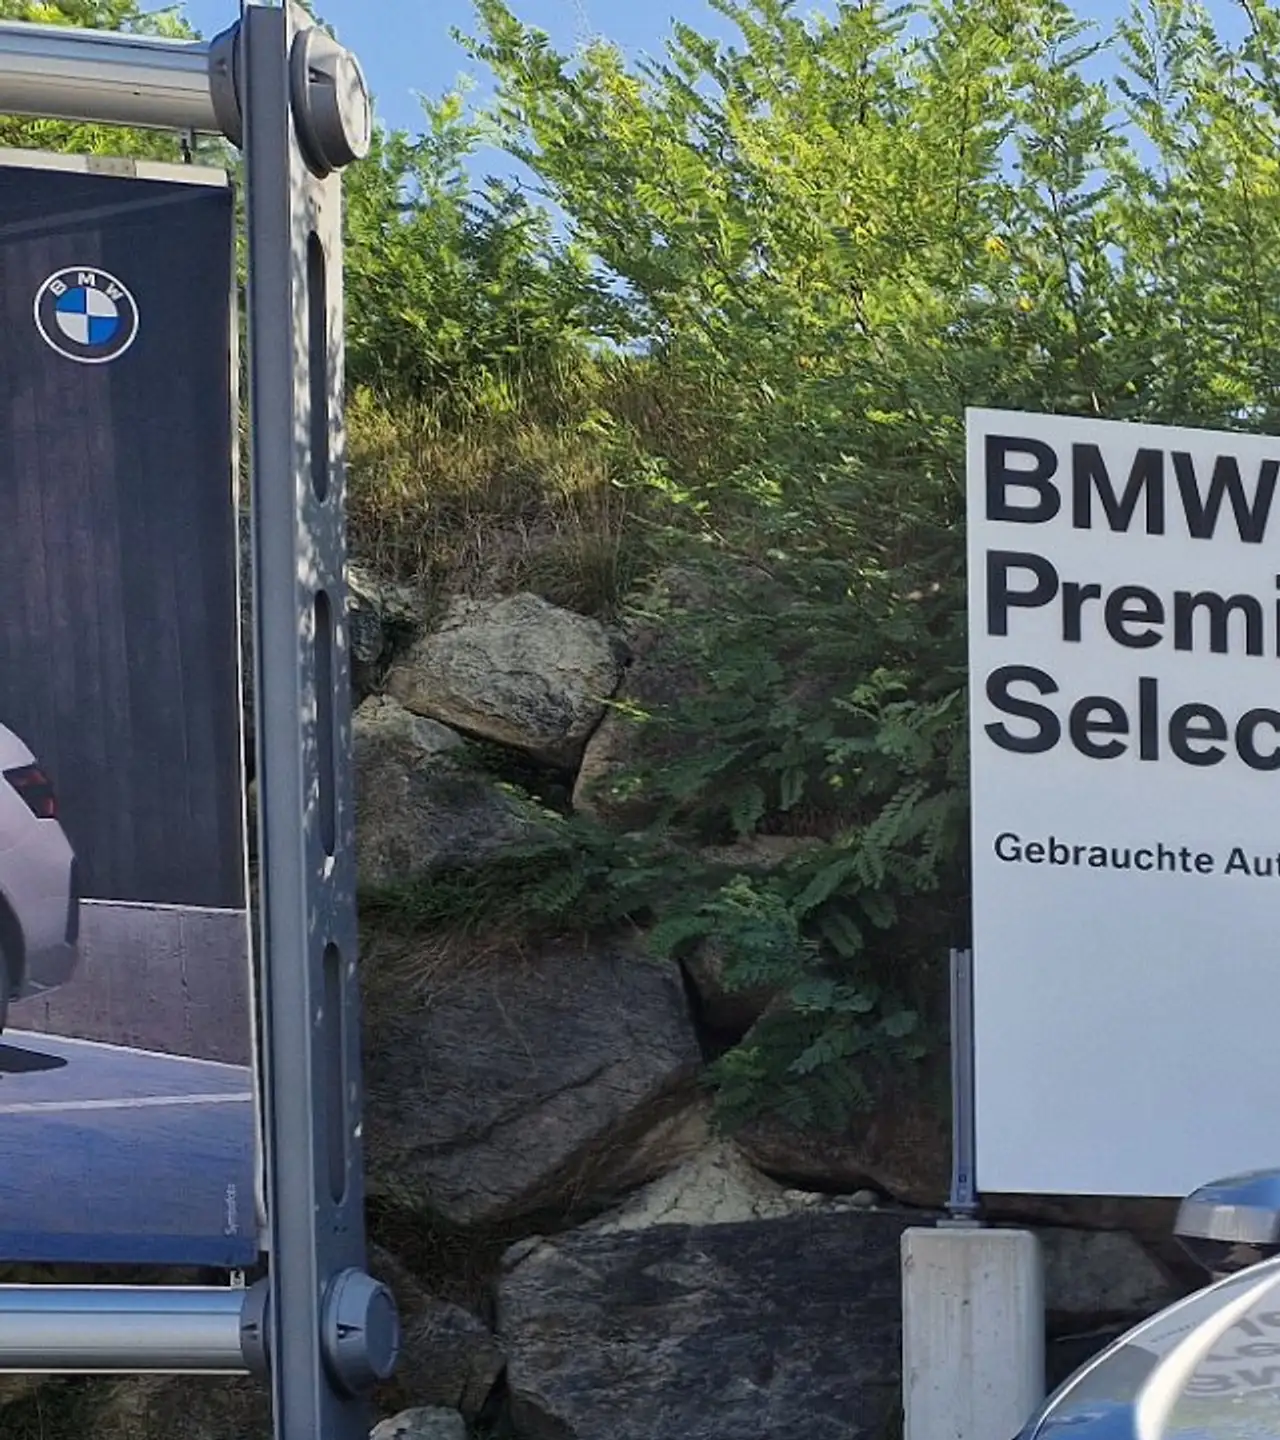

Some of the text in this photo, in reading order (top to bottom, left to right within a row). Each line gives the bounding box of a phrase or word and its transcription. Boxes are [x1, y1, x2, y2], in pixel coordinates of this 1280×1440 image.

[50, 272, 124, 301] BMW
[984, 434, 1280, 544] BMW
[994, 832, 1214, 875] Gebrauchte
